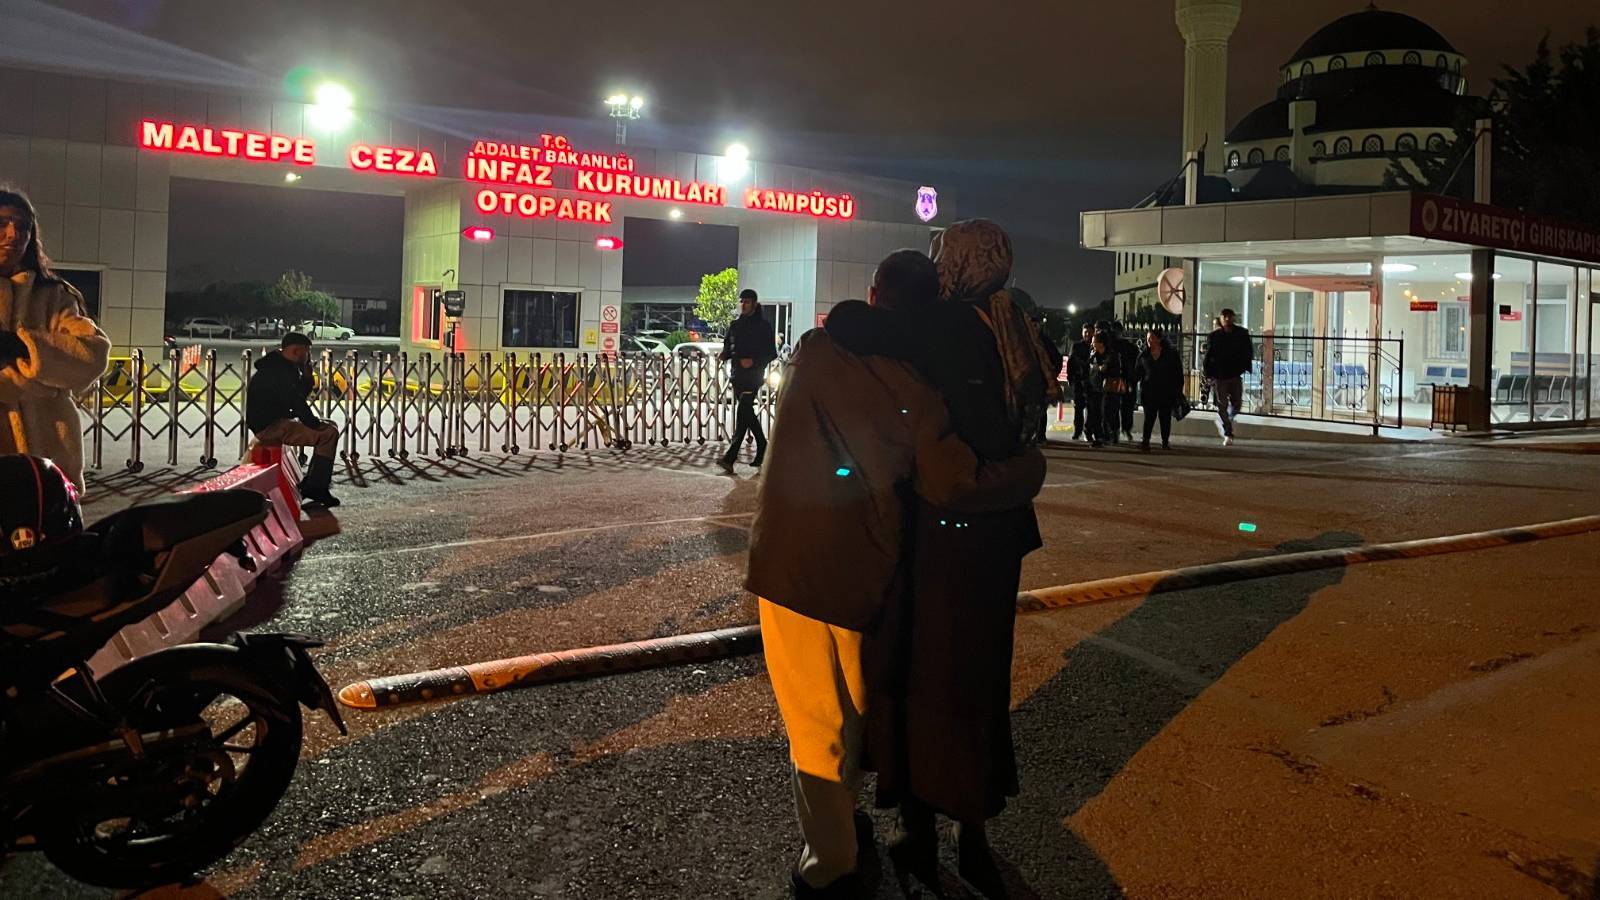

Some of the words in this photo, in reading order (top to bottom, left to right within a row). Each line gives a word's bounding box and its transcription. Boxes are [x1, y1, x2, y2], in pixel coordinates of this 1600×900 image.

[474, 141, 541, 161] ADALET
[545, 149, 633, 172] BAKANLIĞI
[541, 134, 571, 150] T.C.
[141, 120, 315, 164] MALTEPE
[350, 145, 437, 175] CEZA
[466, 152, 553, 186] İNFAZ
[577, 169, 727, 206] KURUMLARI
[746, 190, 853, 218] KAMPÜSÜ
[477, 189, 612, 223] OTOPARK
[1442, 202, 1525, 248] ZİYARETÇİ
